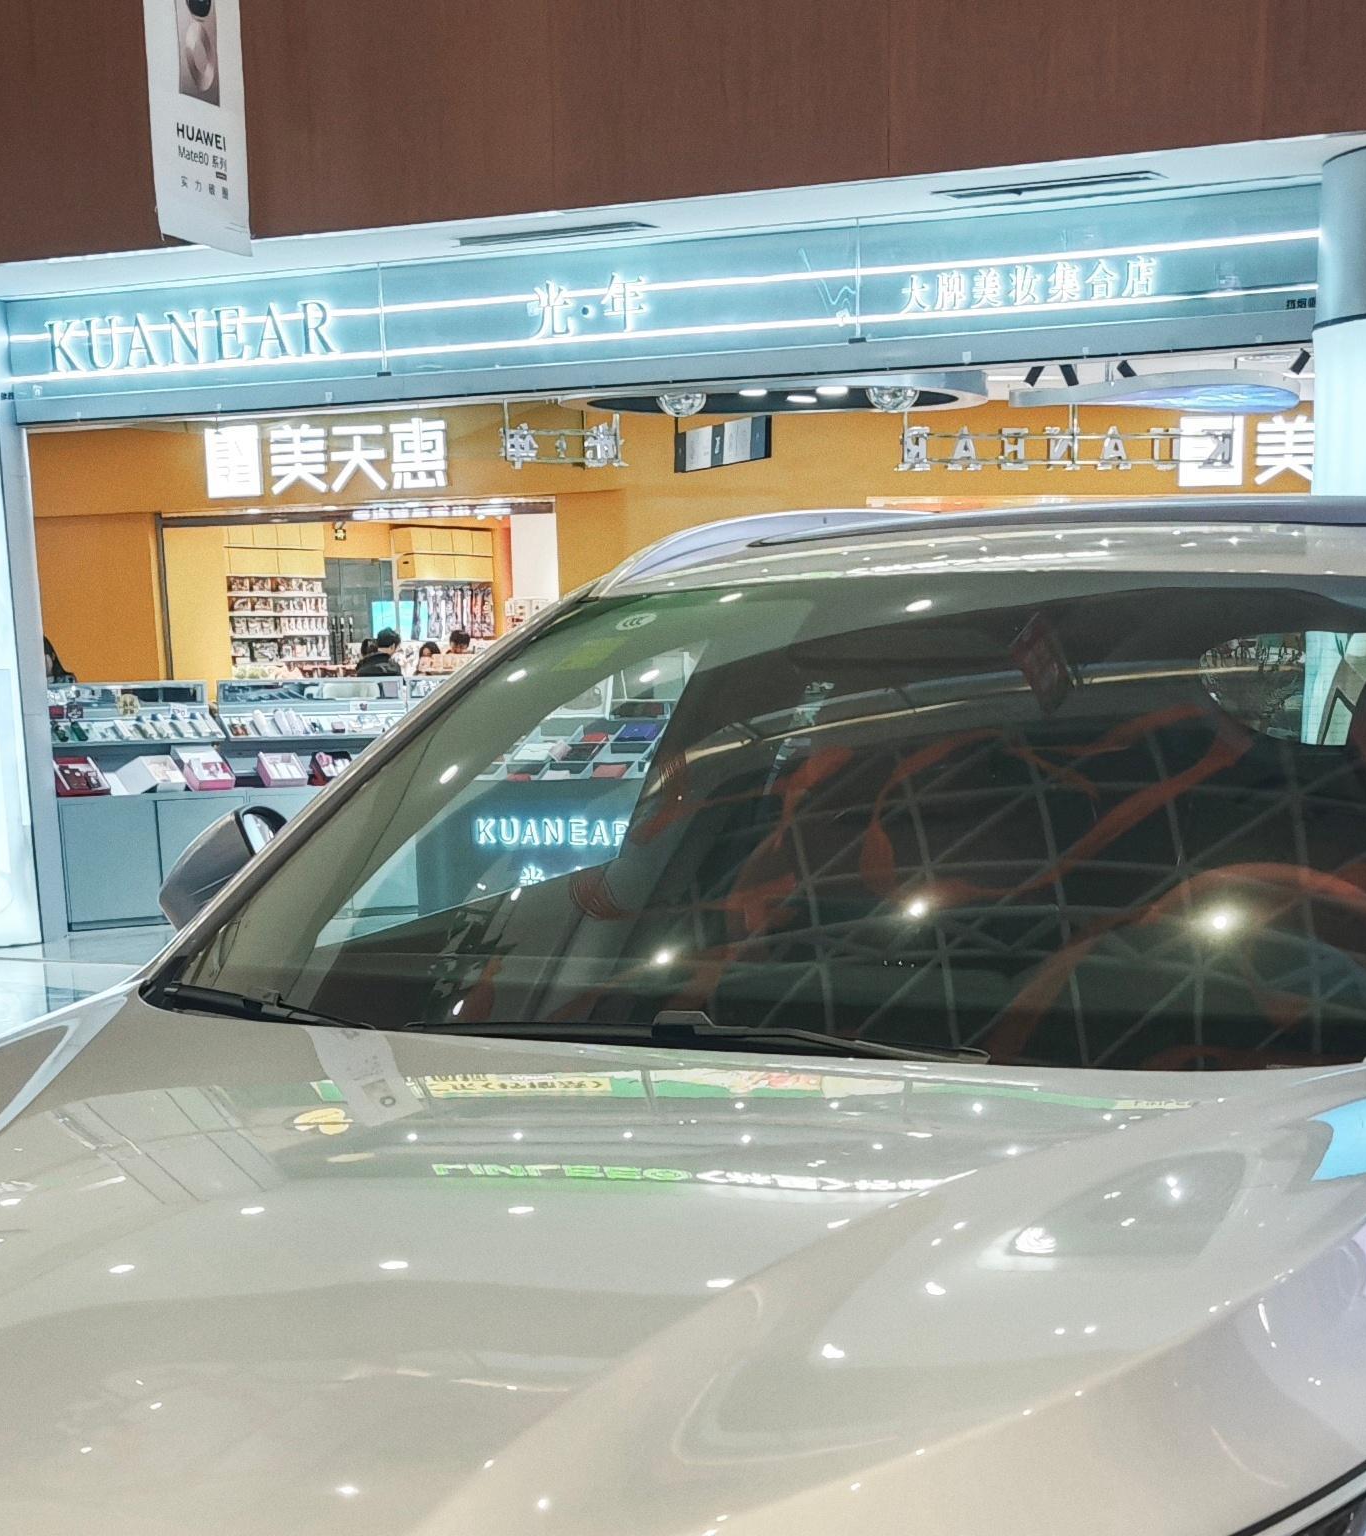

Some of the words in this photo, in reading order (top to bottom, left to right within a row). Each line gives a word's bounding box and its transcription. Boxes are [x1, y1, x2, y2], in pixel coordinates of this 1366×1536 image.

[176, 122, 227, 152] HUAWEI
[901, 255, 1157, 313] 大牌美妆集合店
[44, 300, 342, 373] KUANEAR
[270, 416, 447, 495] 美天惠
